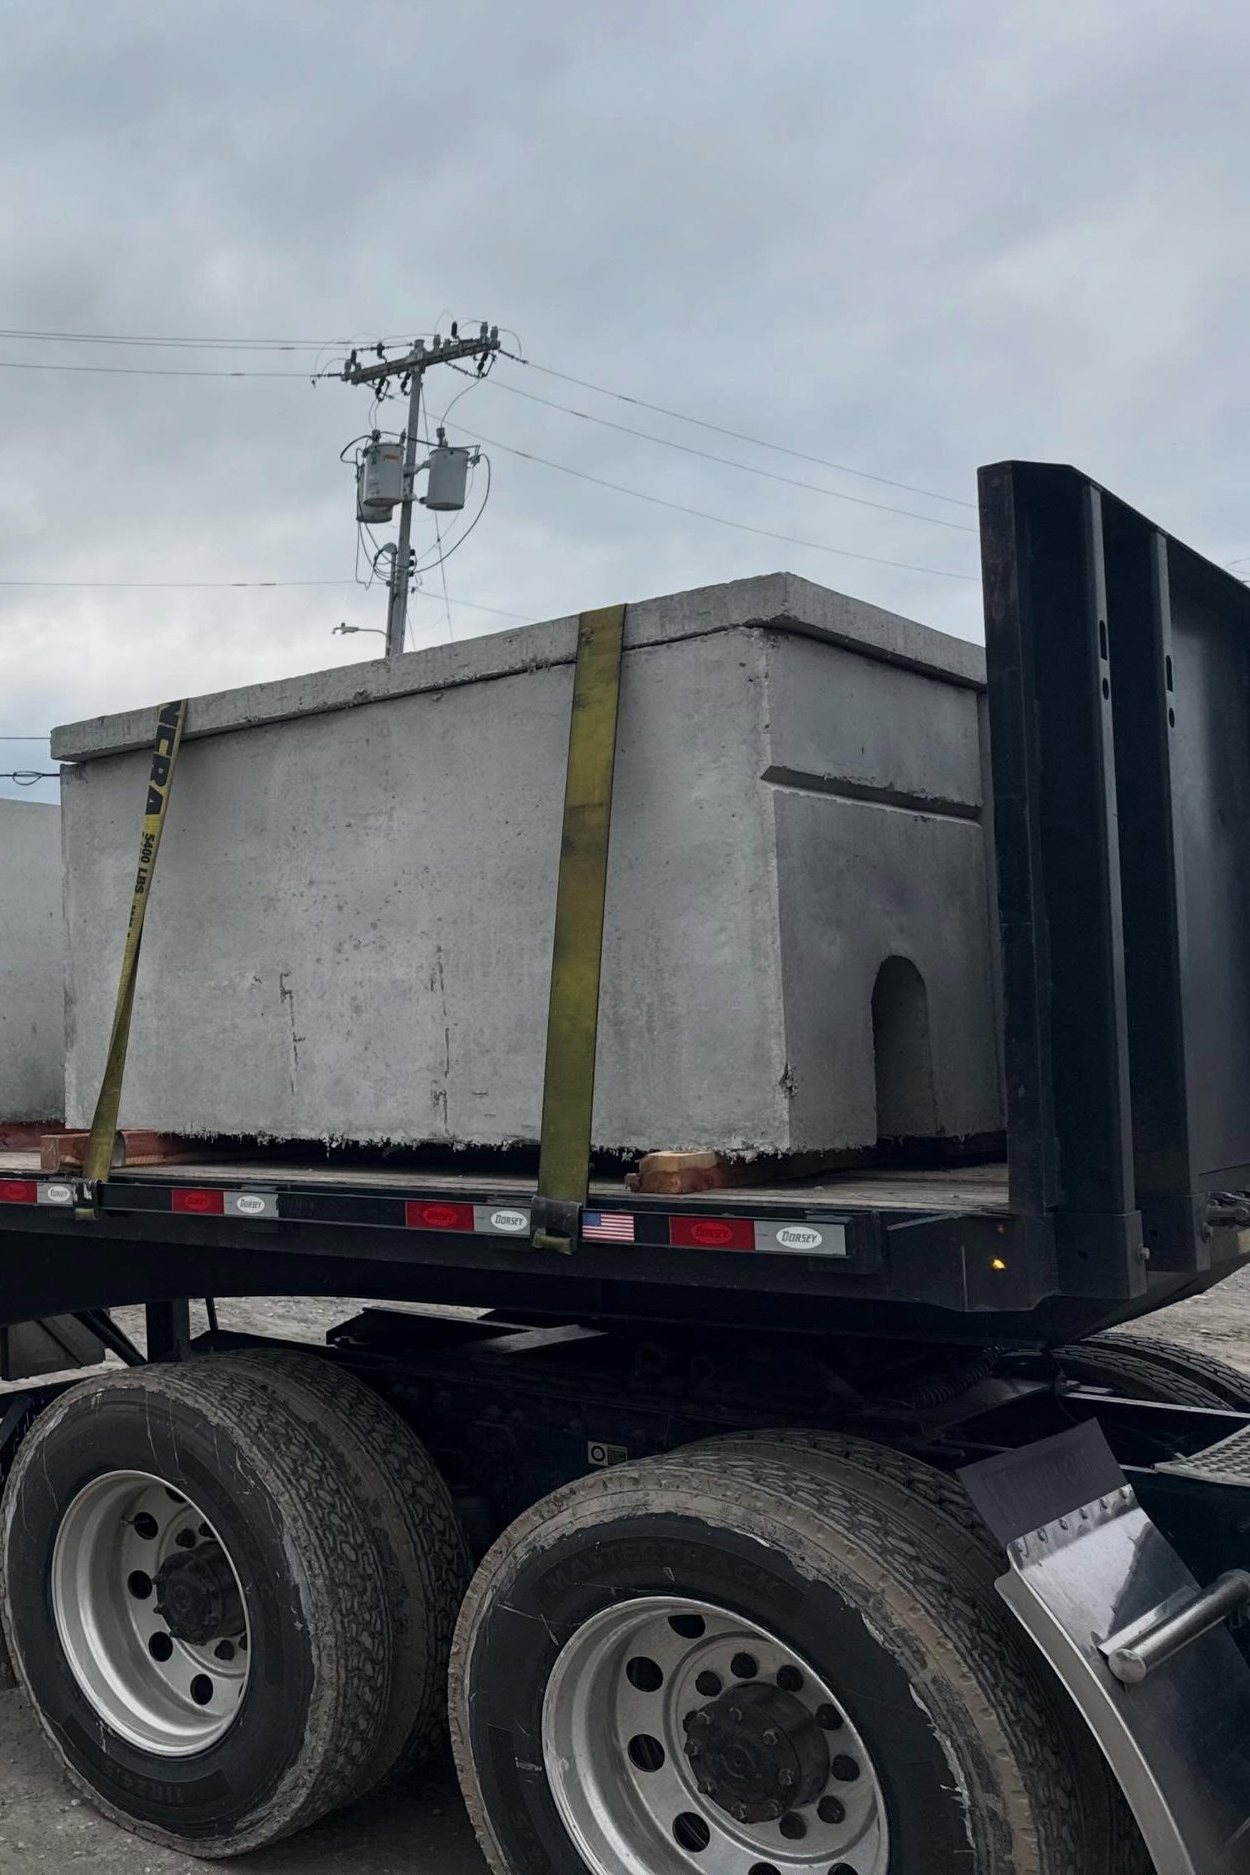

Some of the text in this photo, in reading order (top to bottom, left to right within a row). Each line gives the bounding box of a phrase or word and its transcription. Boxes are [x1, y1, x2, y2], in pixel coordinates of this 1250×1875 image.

[134, 833, 155, 894] 5400 LBS
[494, 1213, 524, 1227] DORSEY
[781, 1230, 818, 1244] DORSEY
